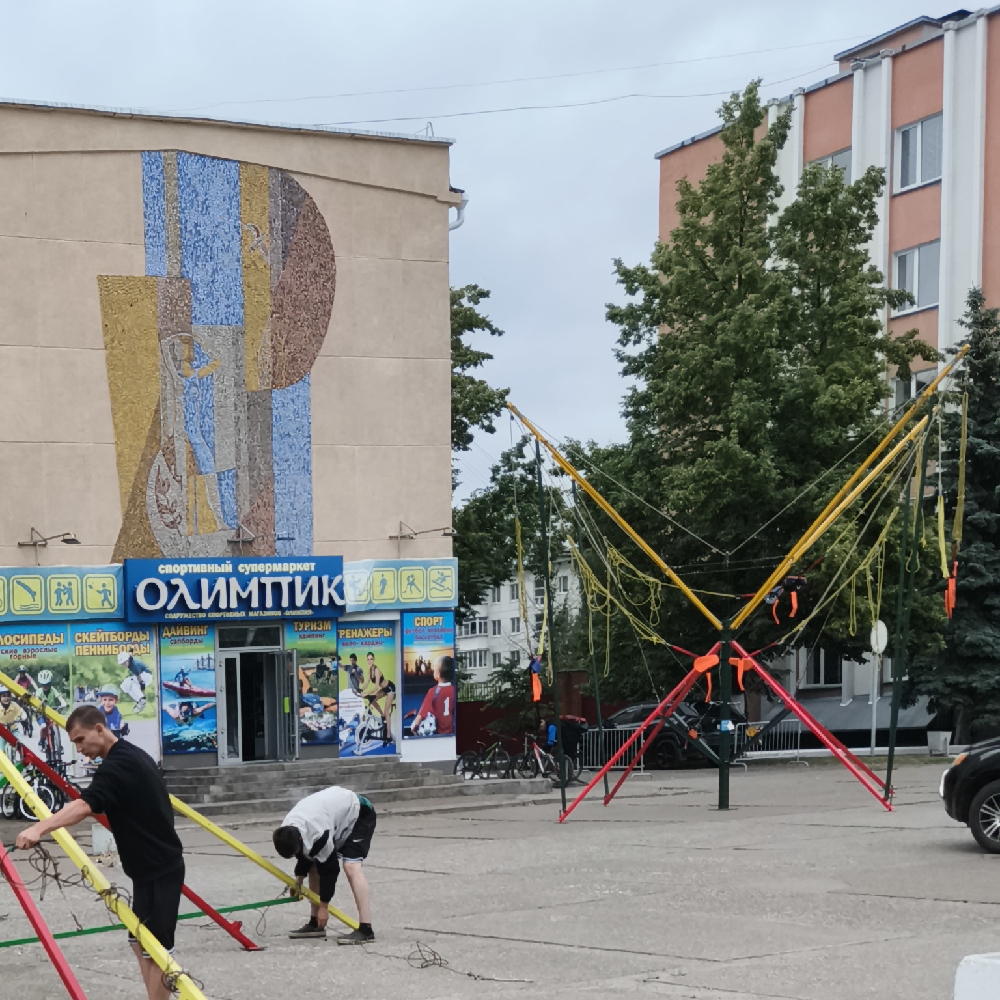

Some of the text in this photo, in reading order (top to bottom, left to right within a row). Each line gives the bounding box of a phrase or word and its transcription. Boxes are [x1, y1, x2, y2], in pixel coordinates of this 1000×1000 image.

[158, 560, 316, 575] спортивный супермаркет
[135, 574, 346, 611] ОЛИМПИК
[293, 620, 332, 631] ТУРИЗМ
[414, 616, 444, 627] СПОРТ
[74, 629, 150, 643] СКЕЙТБОРДЫ
[162, 623, 209, 638] ДАЙВИНГ
[74, 643, 150, 656] ПЕННИБОРДЫ
[443, 696, 450, 716] 1
